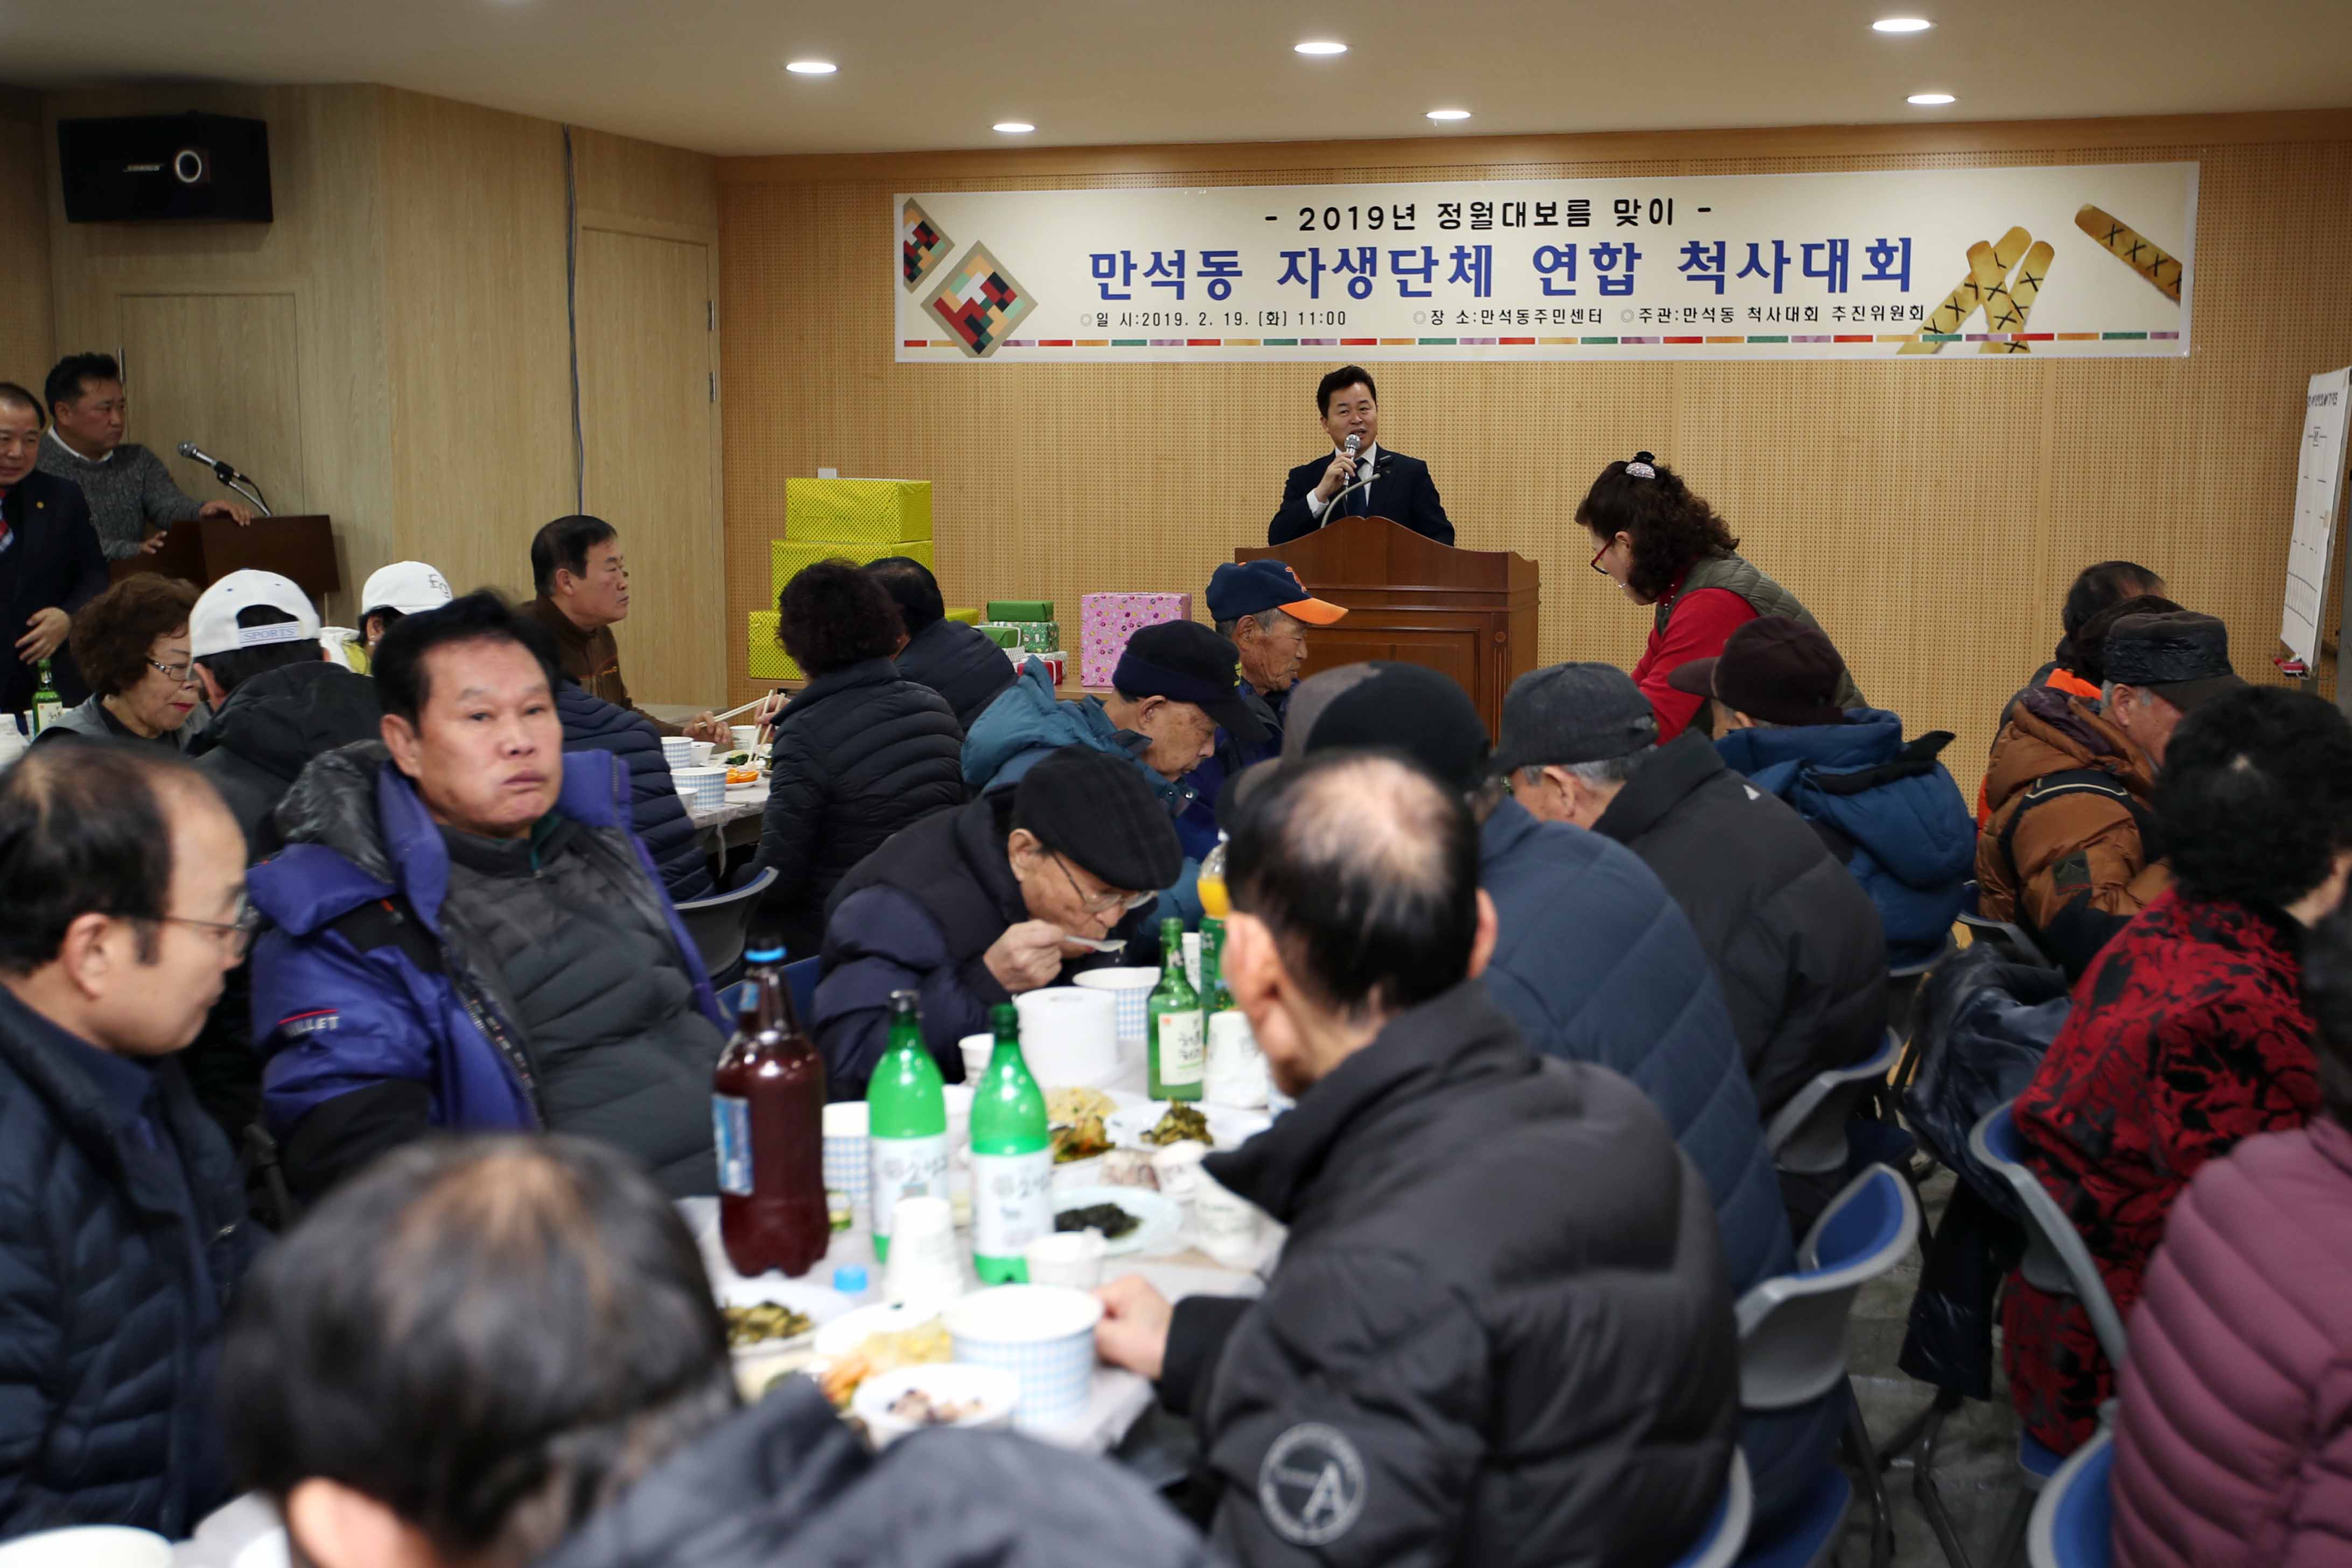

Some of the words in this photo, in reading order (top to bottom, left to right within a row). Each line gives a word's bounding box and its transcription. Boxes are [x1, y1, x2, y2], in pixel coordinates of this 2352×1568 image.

[1299, 204, 1415, 231] 2019년
[1438, 199, 1591, 230] 정월대보름
[1614, 198, 1673, 227] 맞이
[1089, 249, 1243, 301] 만석동
[1277, 245, 1492, 300] 자생단체
[1532, 242, 1642, 296] 연합
[1677, 237, 1912, 295] 척사대회
[1096, 312, 1108, 327] 일
[1120, 312, 1188, 327] 시:2019.
[1199, 312, 1213, 326] 2.
[1224, 312, 1248, 326] 19.
[1299, 311, 1346, 325] 11:00
[1432, 310, 1444, 326] 장
[1457, 309, 1601, 325] 소:만석동주민센터
[1639, 307, 1734, 323] 주관:만석동
[1748, 306, 1818, 323] 척사대회
[1832, 305, 1923, 321] 추진위원회
[244, 628, 295, 640] SPORTS
